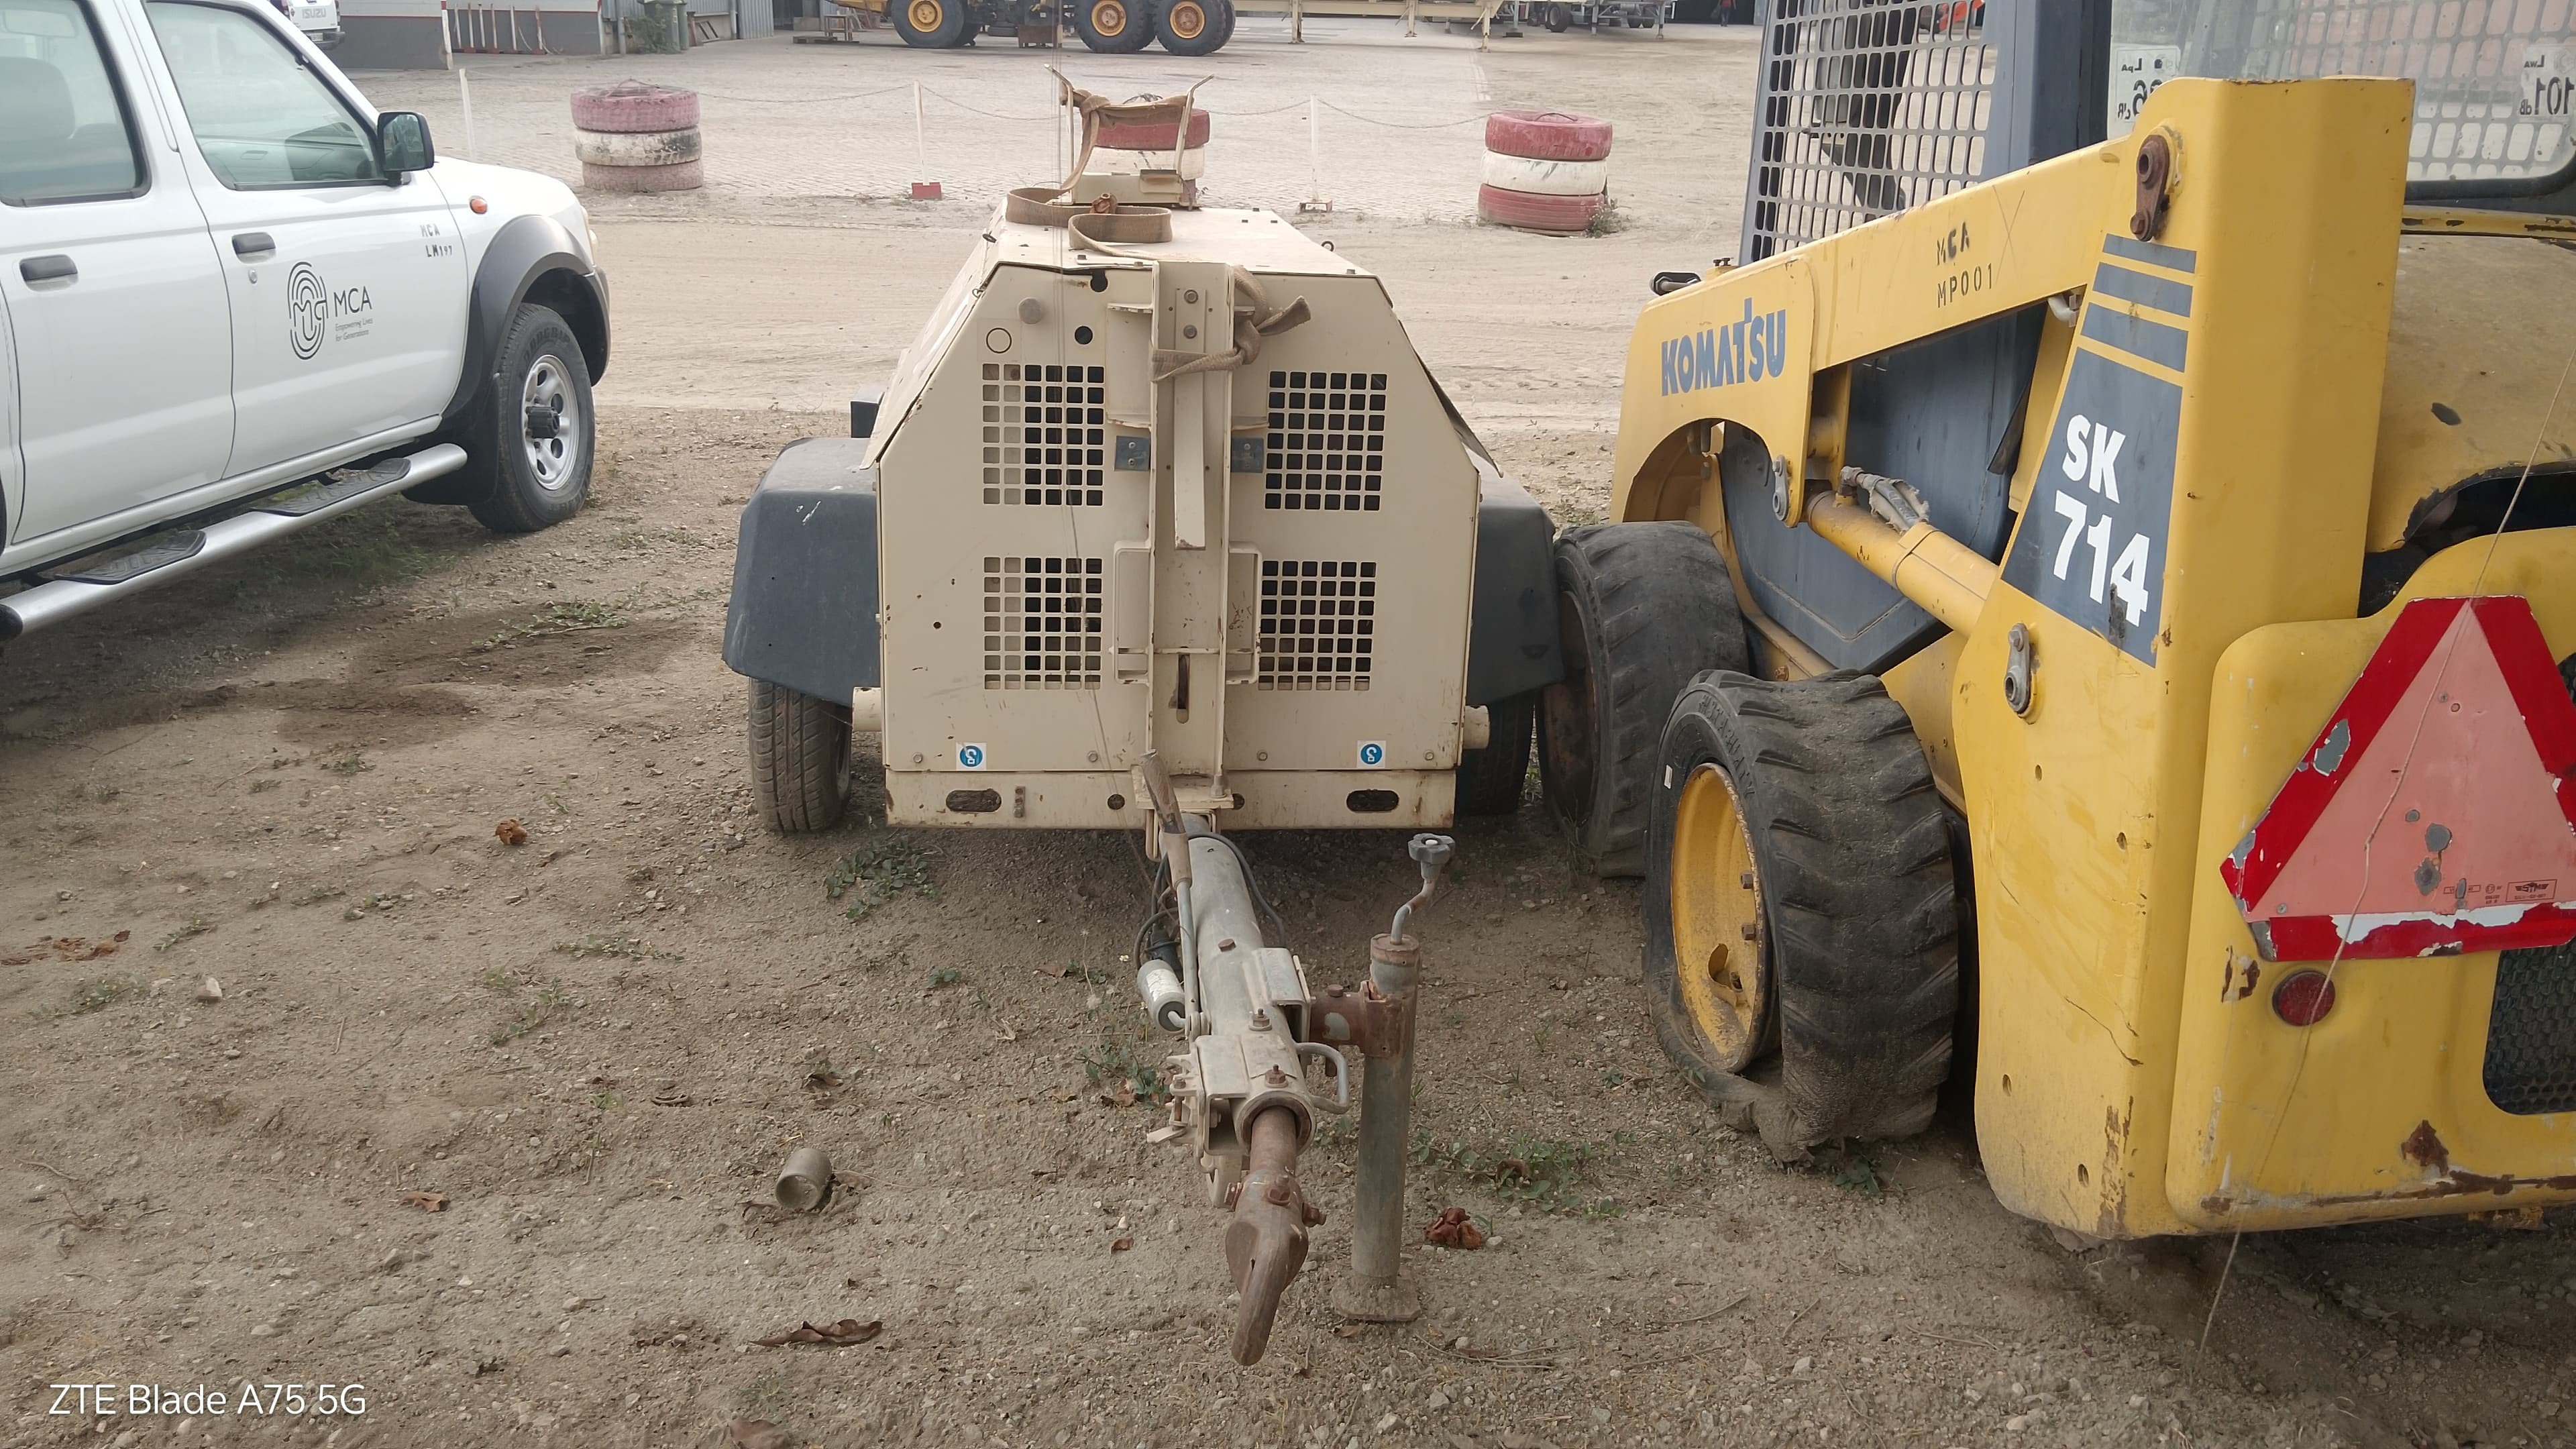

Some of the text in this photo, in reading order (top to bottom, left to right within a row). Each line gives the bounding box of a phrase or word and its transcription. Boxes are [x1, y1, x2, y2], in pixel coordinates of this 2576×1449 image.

[302, 7, 326, 19] ISUZU
[1936, 221, 1970, 266] MCA
[333, 286, 372, 317] MCA
[1937, 262, 1992, 309] MP001
[1662, 297, 1786, 396] KOMATSU
[2062, 414, 2127, 504] SK
[2053, 490, 2151, 627] 714
